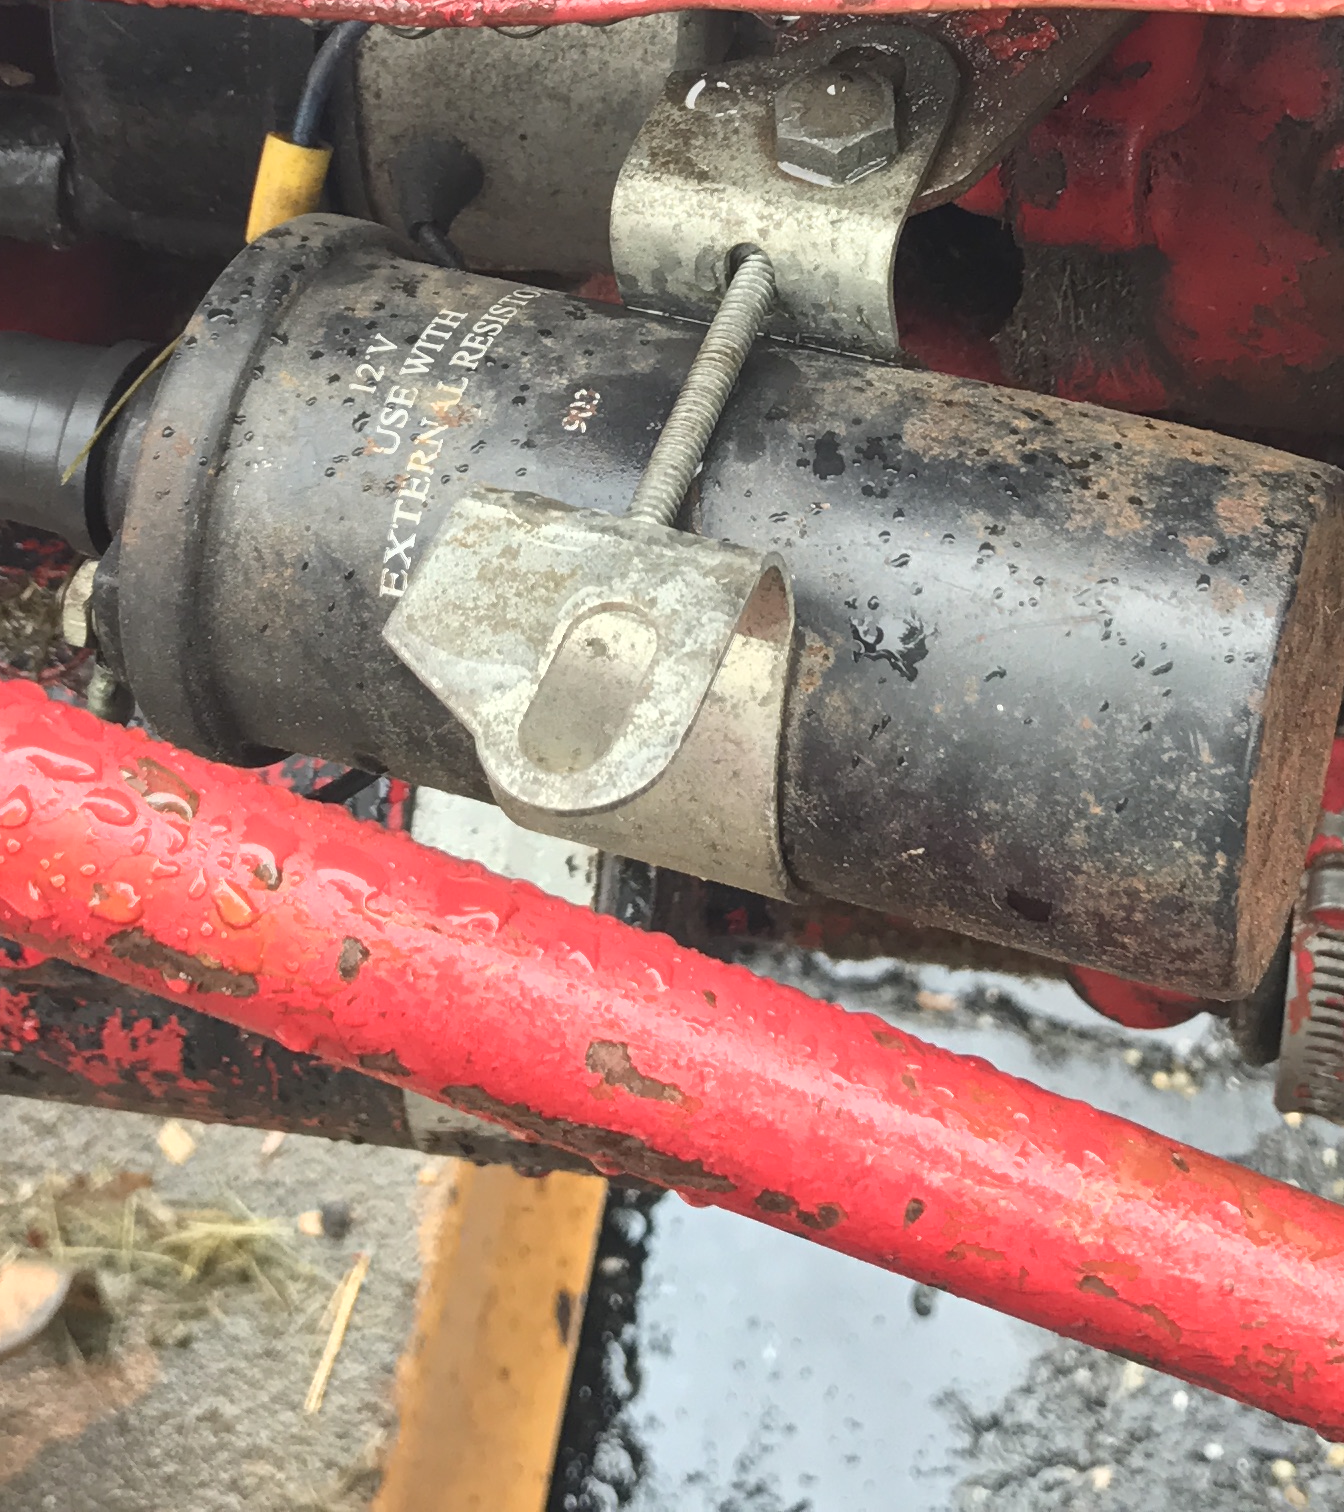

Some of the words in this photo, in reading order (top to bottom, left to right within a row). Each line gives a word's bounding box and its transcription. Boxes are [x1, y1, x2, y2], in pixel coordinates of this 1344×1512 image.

[368, 385, 419, 455] USE
[399, 308, 469, 376] WITH
[379, 376, 469, 598] EXTERNAL
[448, 287, 548, 370] RESISTO
